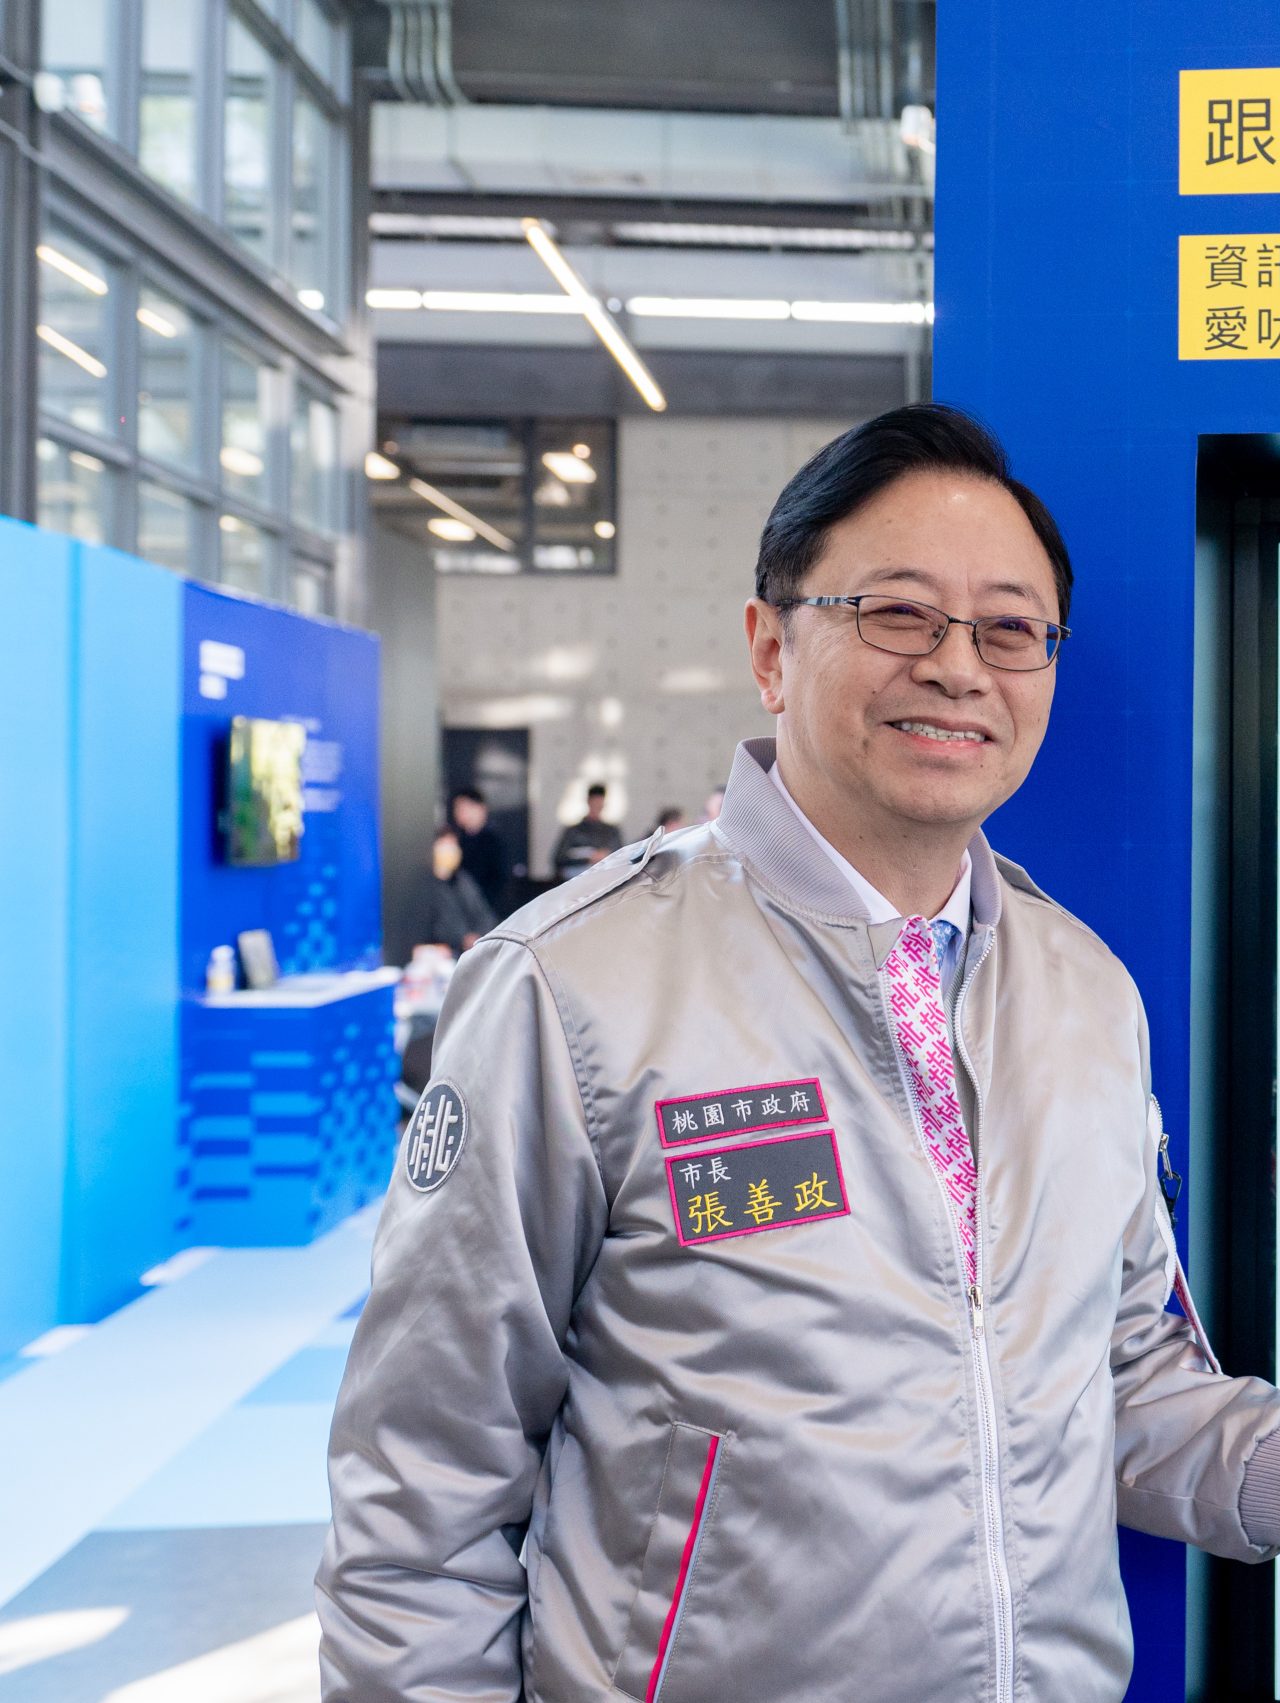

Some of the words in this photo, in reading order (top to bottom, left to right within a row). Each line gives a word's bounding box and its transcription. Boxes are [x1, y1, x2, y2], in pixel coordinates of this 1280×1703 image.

[672, 1090, 811, 1134] 桃園市政府
[679, 1156, 732, 1190] 市長
[687, 1171, 838, 1234] 張善政
